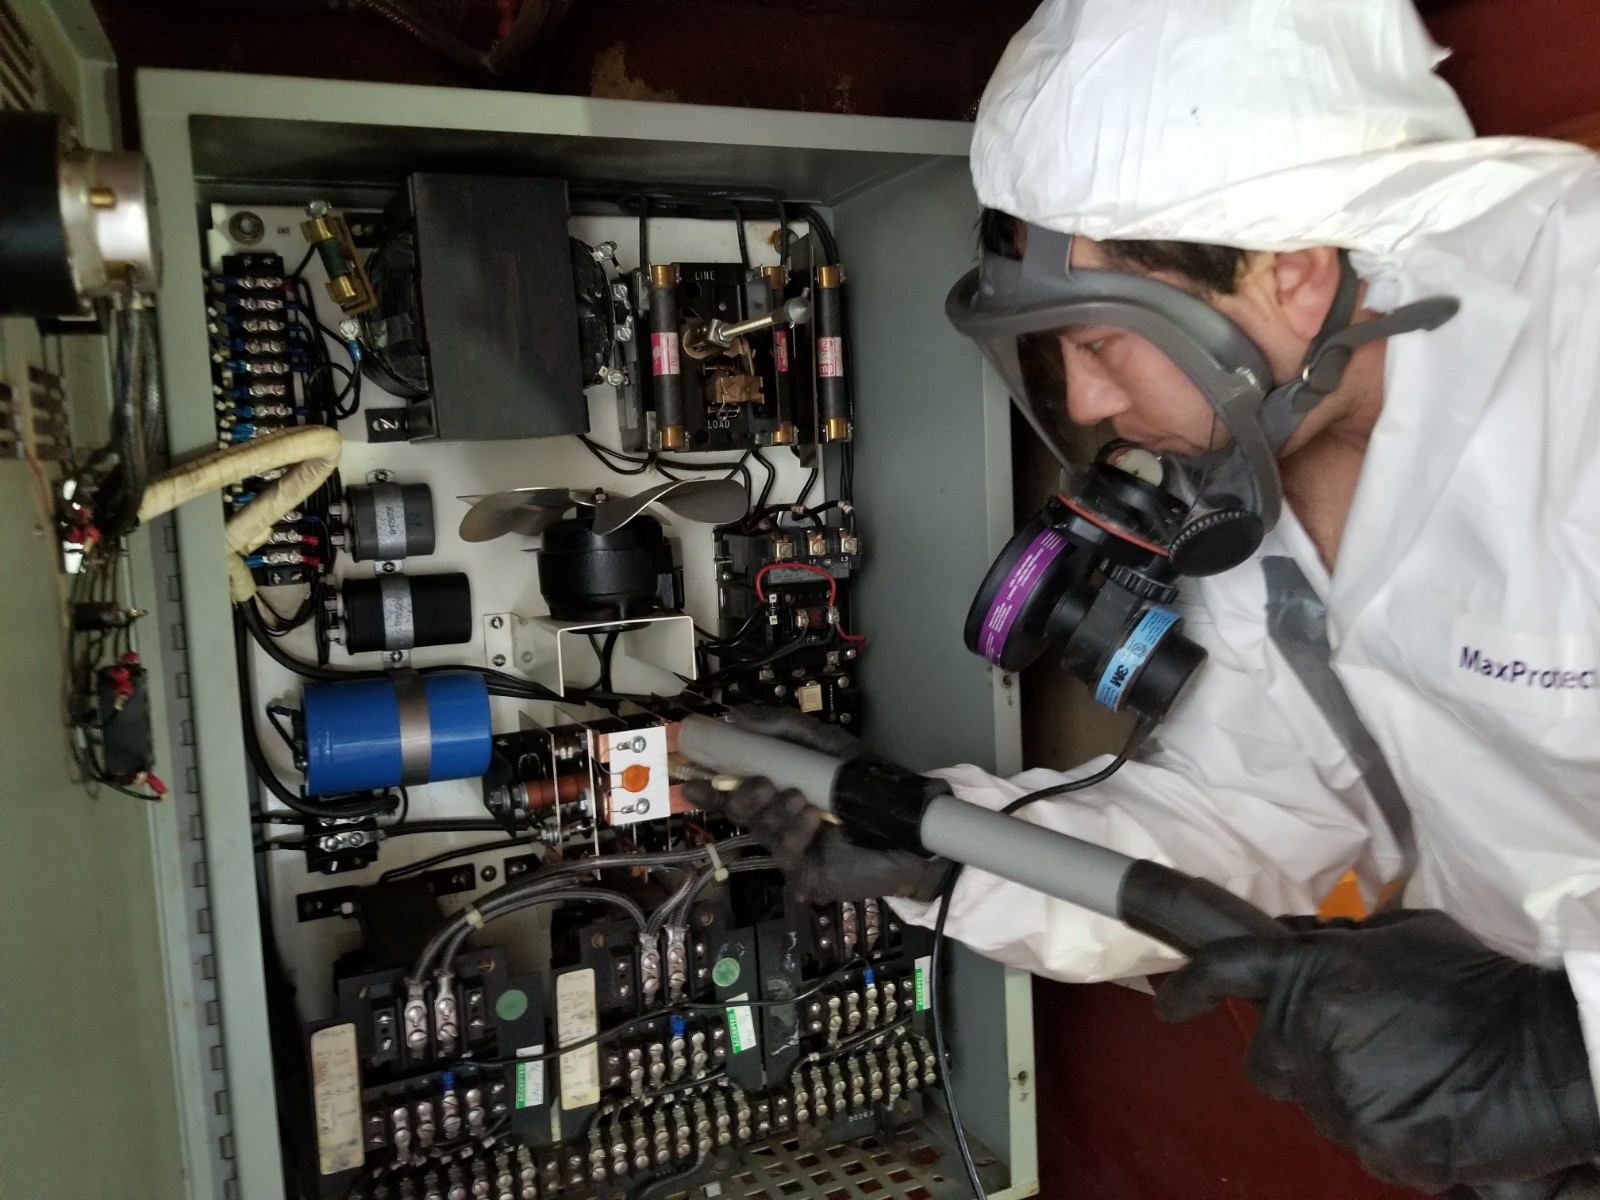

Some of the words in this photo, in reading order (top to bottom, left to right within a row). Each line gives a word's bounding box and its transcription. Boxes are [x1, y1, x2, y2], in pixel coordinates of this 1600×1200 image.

[694, 271, 715, 281] LINE
[707, 420, 730, 429] LOAD
[1109, 664, 1128, 688] 3M
[728, 1012, 741, 1049] ACCEPTED
[517, 1064, 525, 1102] ACCEPTED
